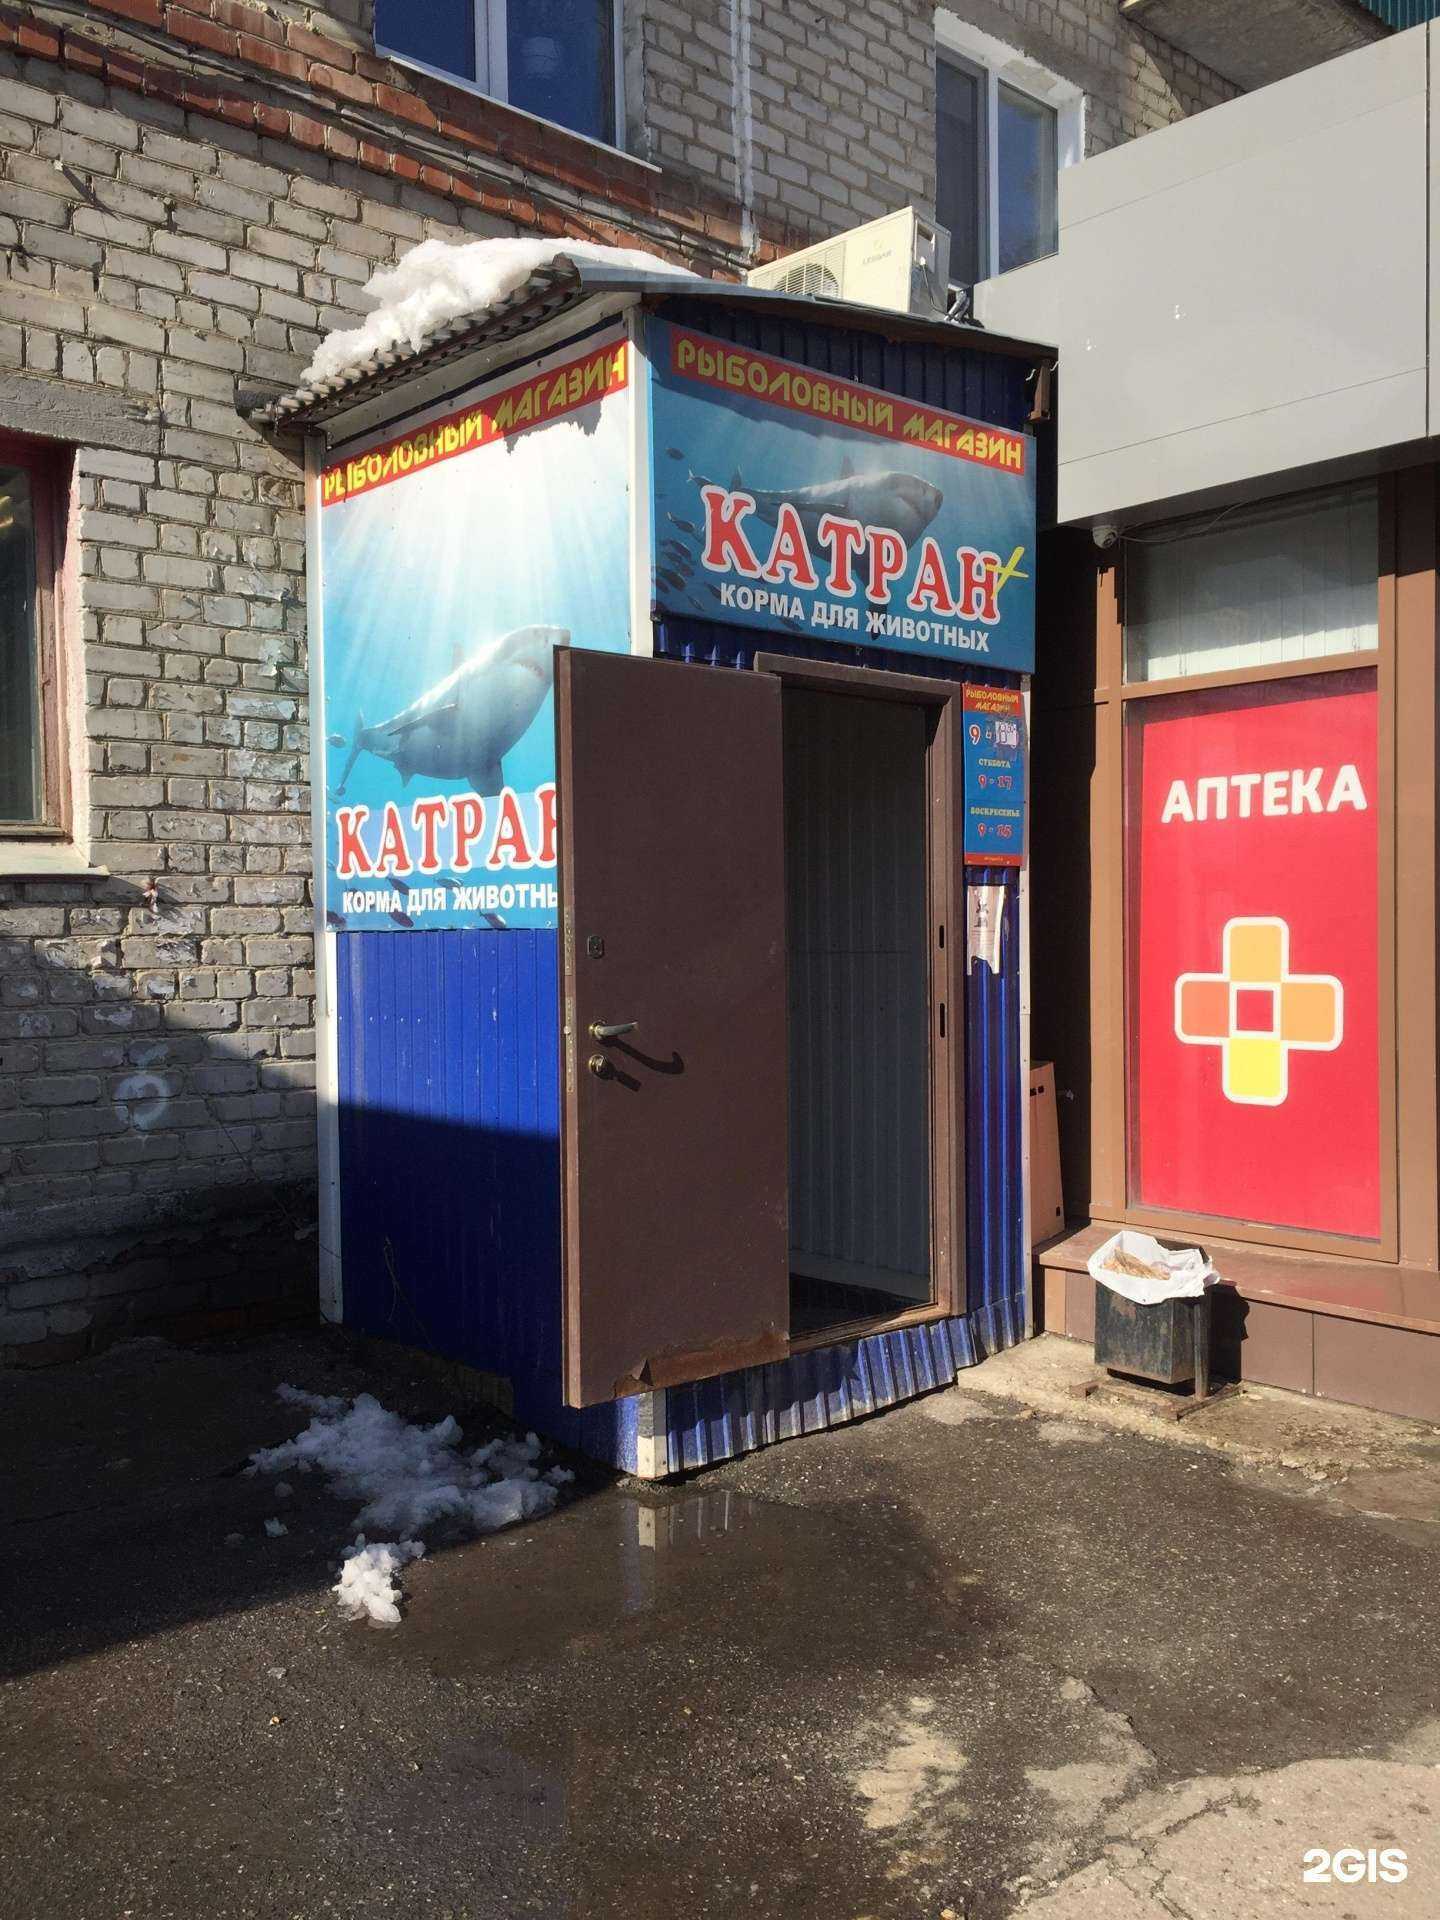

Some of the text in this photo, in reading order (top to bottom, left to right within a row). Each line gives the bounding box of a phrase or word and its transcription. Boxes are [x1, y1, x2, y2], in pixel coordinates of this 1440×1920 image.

[324, 346, 626, 500] РЫБОЛОВНЫЙ МАГАЗИН
[677, 339, 1023, 469] РЫБОЛОВНЫЙ МАГАЗИН
[720, 583, 990, 653] КОРМА ДЛЯ ЖИВОТНЫХ
[969, 724, 980, 745] 9
[1160, 764, 1368, 824] АПТЕКА
[342, 889, 403, 914] КОРМА
[407, 888, 447, 916] ДЛЯ
